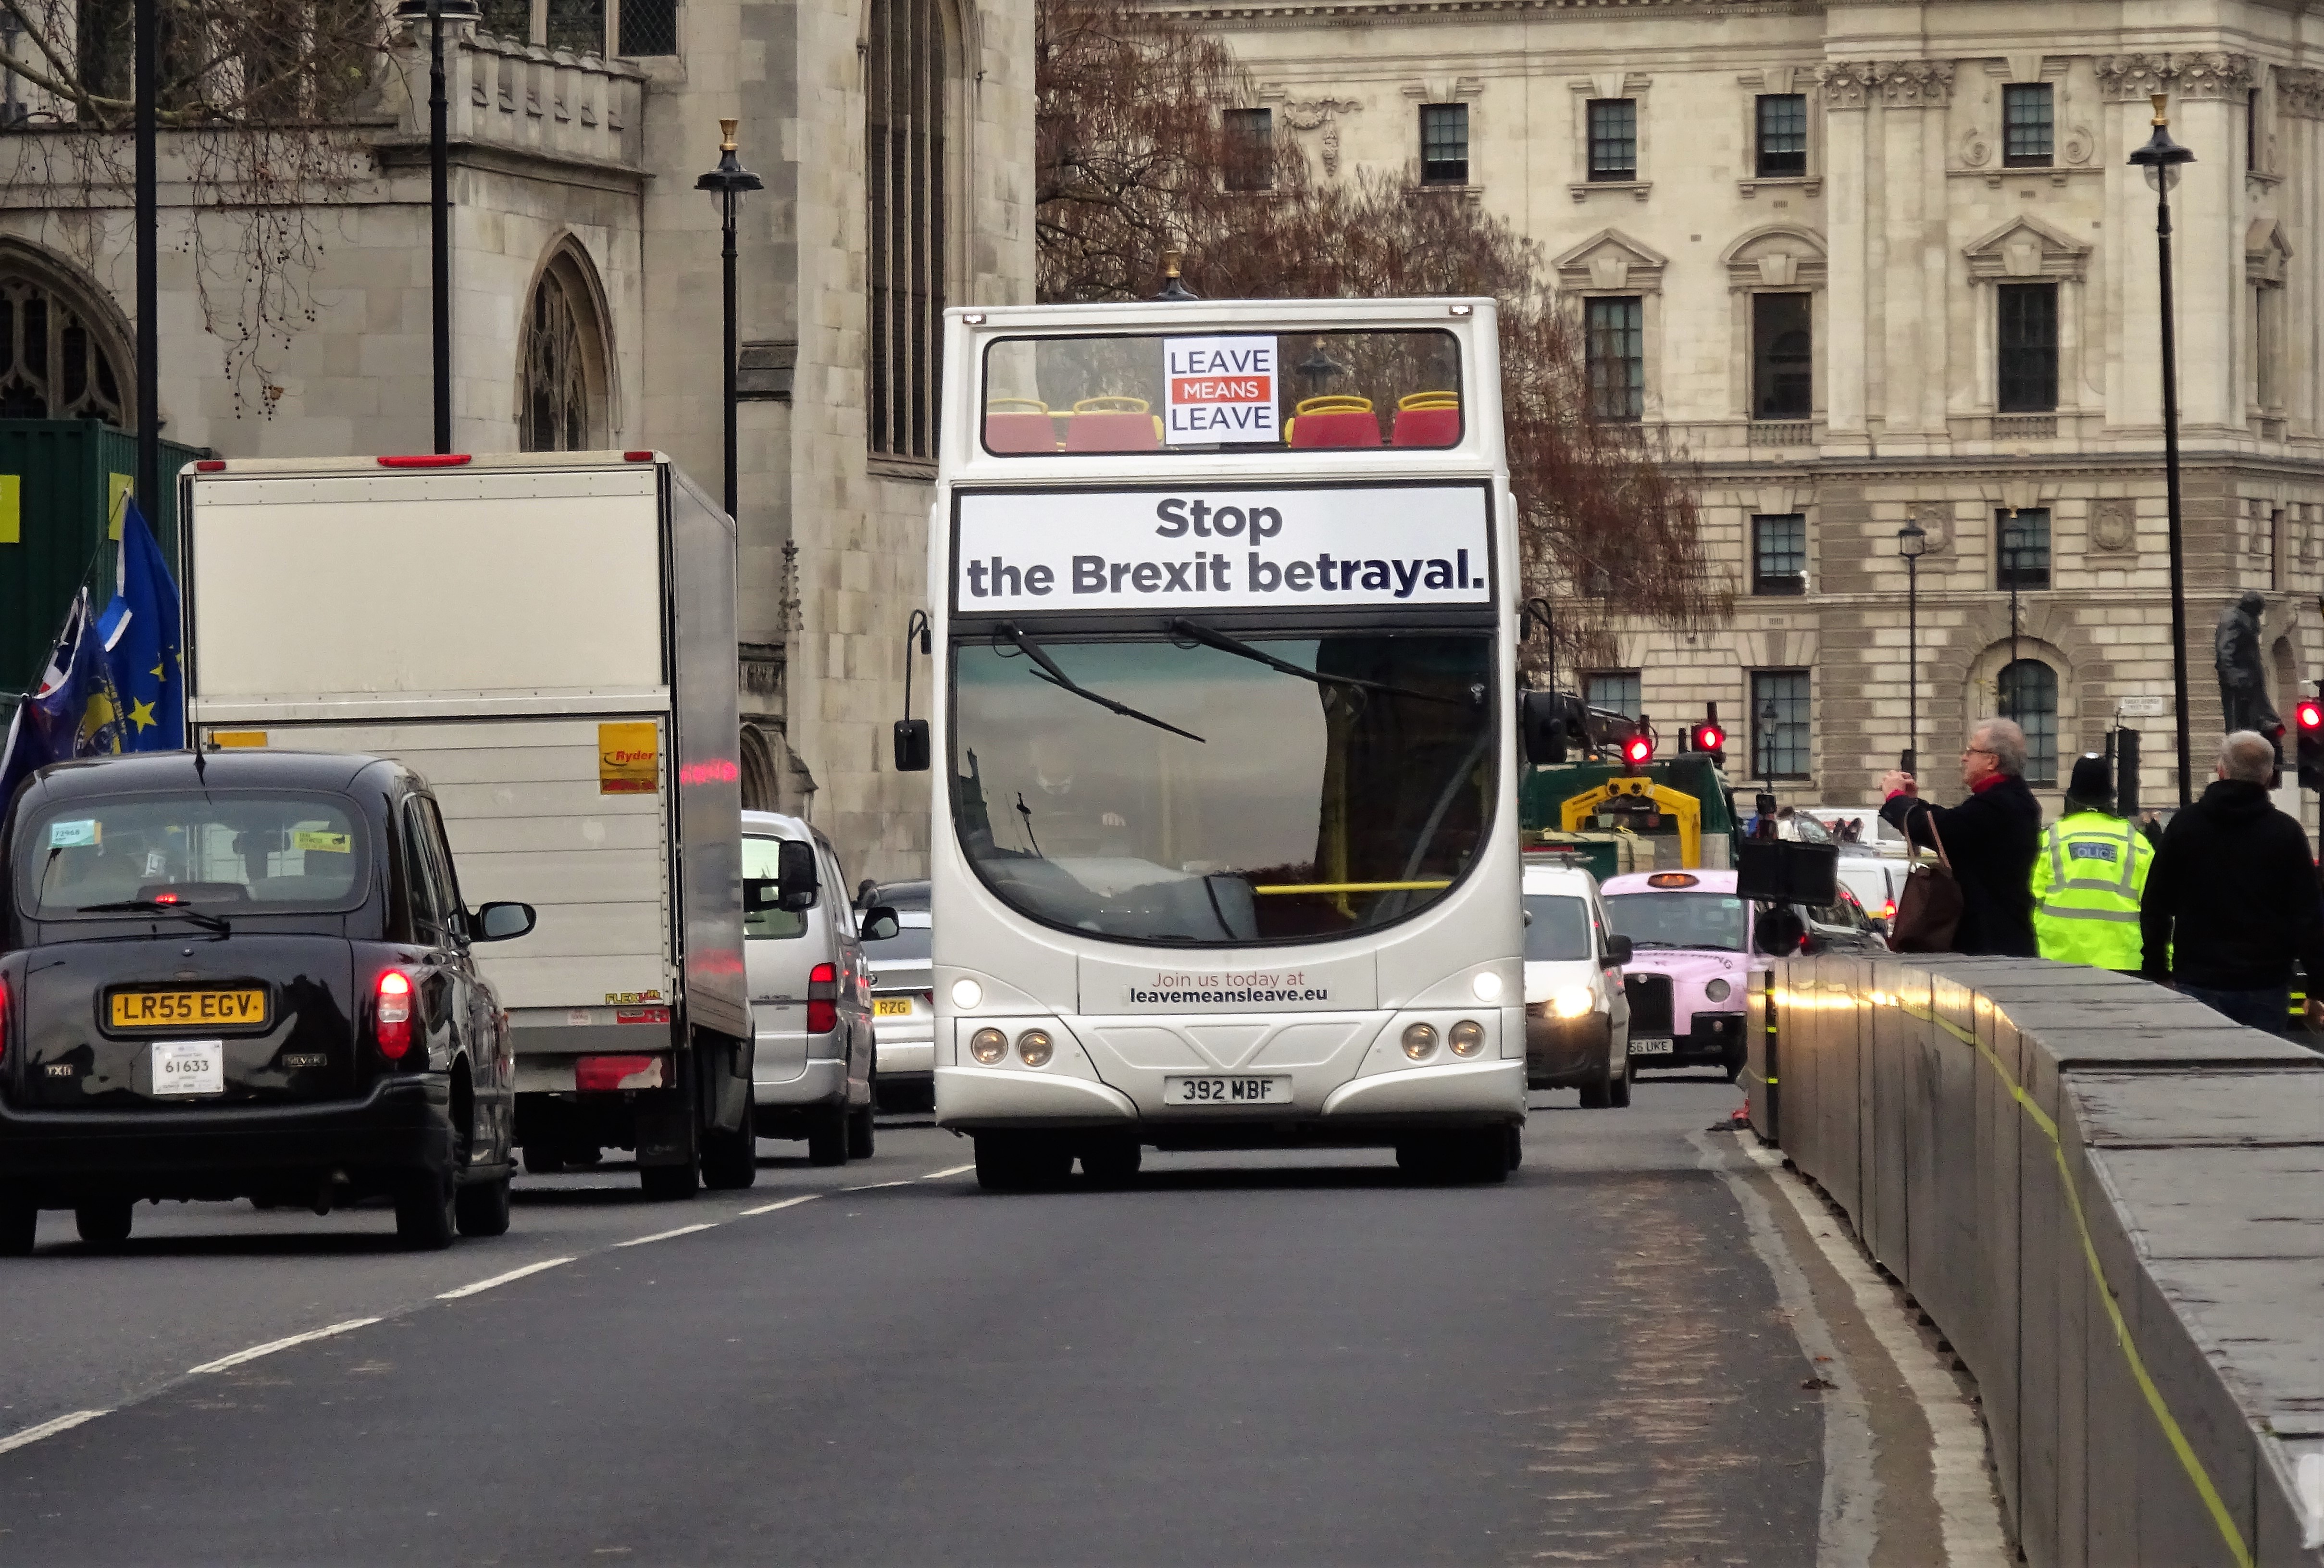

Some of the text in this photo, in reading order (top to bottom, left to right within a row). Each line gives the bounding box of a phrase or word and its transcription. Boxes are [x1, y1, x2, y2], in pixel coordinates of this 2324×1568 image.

[1171, 349, 1271, 374] LEAVE
[1183, 381, 1259, 399] MEANS
[1172, 406, 1272, 431] LEAVE
[1155, 498, 1283, 546] Stop
[967, 548, 1485, 598] the Brexit betrayal.
[615, 750, 654, 762] Ryder
[1152, 971, 1305, 988] Join us today at
[1130, 987, 1328, 1003] leavemeansleave.eu
[124, 994, 251, 1019] LR55 EGV
[880, 1002, 906, 1014] RZG
[165, 1060, 209, 1073] 61633
[1183, 1080, 1273, 1100] 392 MBF
